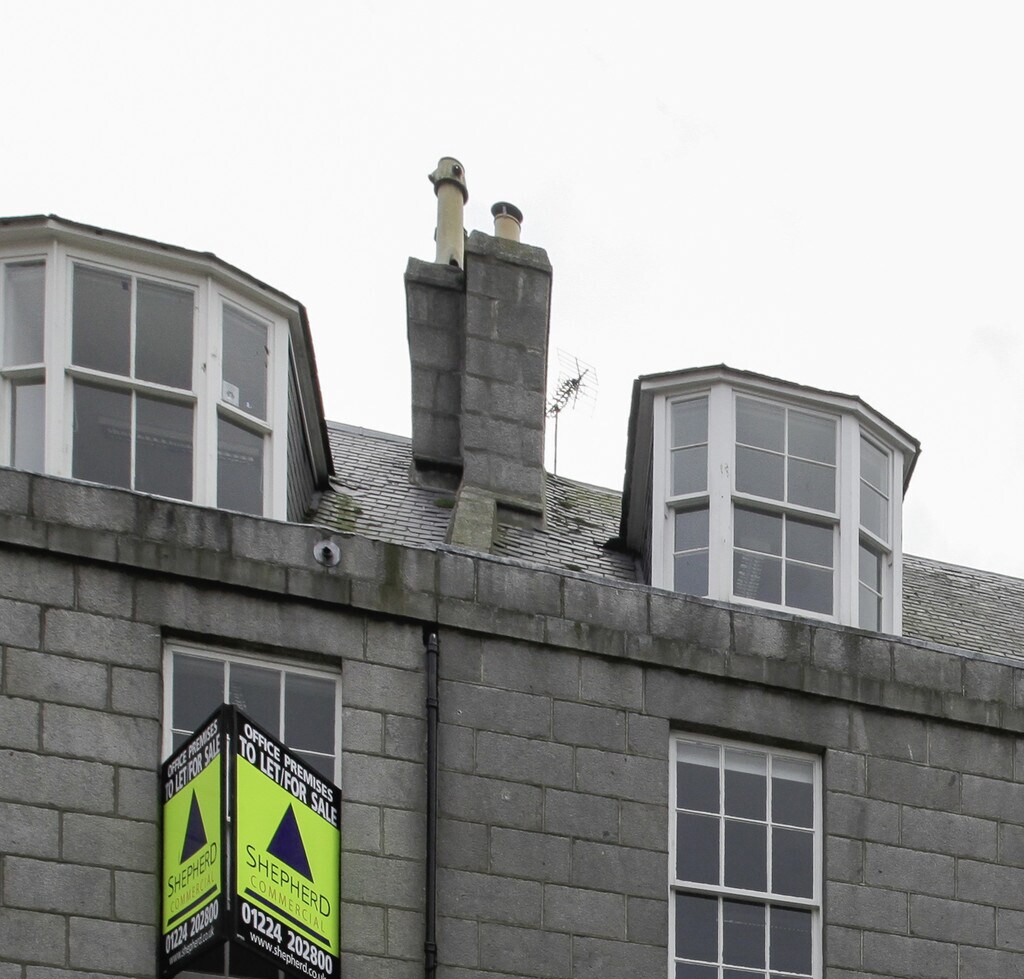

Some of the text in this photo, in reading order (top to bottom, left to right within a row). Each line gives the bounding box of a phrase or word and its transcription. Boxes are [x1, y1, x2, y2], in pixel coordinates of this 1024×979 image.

[165, 779, 174, 801] TO
[204, 733, 220, 767] SALE
[167, 719, 218, 778] OFFICE PREMISES
[244, 723, 334, 802] OFFICE PREMISES
[239, 735, 256, 764] TO
[311, 792, 337, 827] SALE
[167, 842, 218, 898] SHEPHERD
[170, 871, 214, 913] COMMERCIAL
[246, 844, 331, 917] SHEPHERD
[165, 899, 219, 954] 01224 202800
[250, 875, 325, 933] COMMERCIAL
[242, 902, 333, 975] 01224 202800
